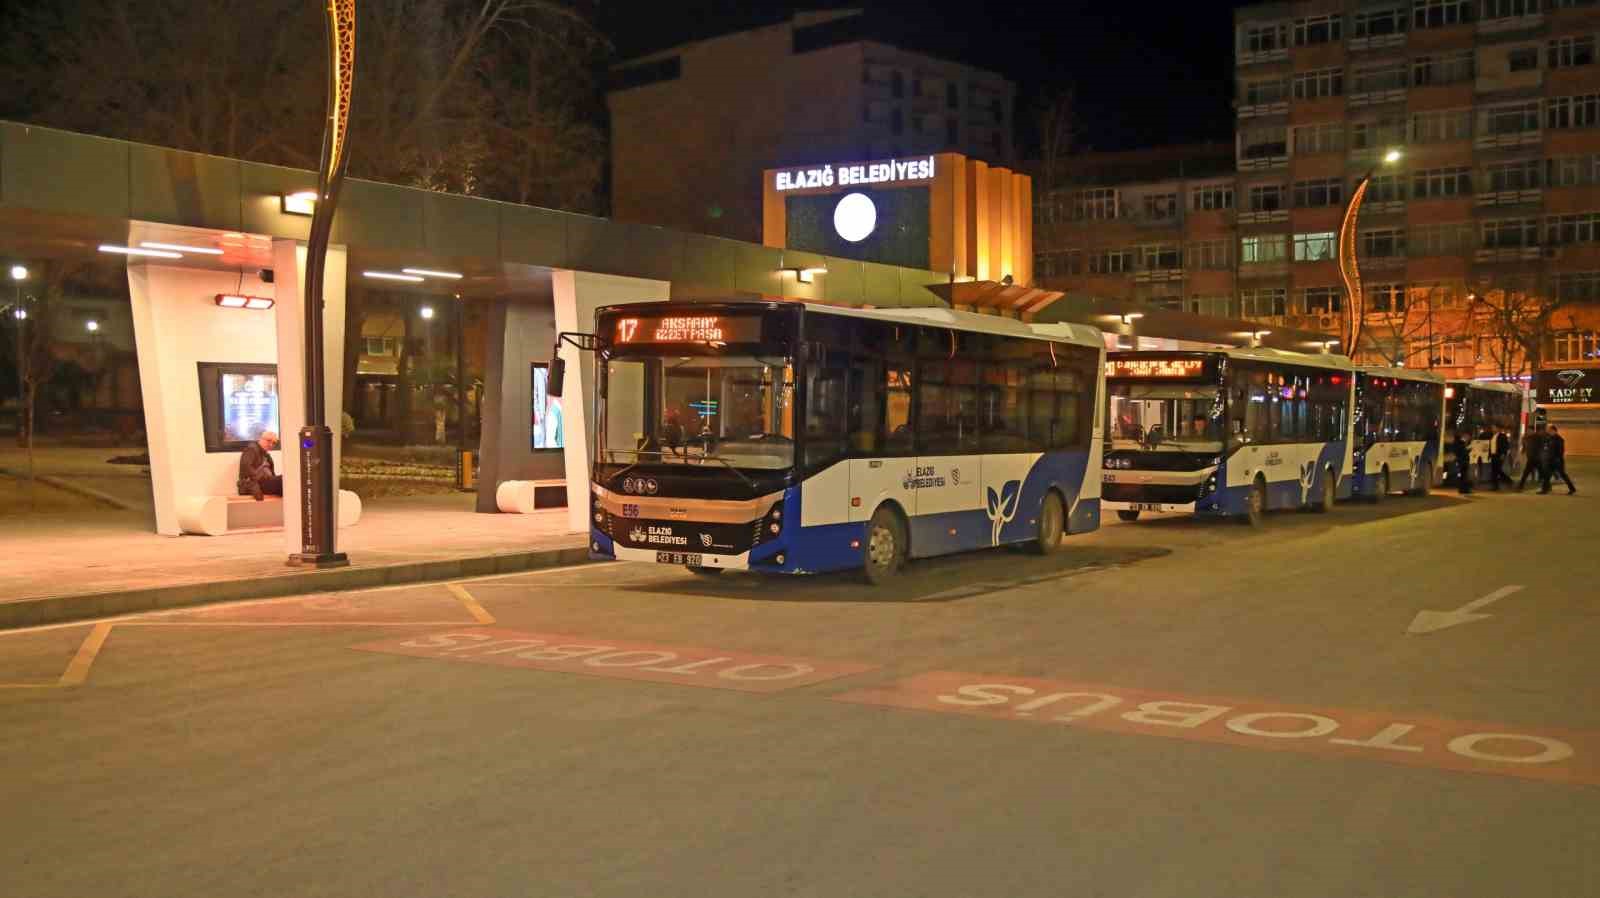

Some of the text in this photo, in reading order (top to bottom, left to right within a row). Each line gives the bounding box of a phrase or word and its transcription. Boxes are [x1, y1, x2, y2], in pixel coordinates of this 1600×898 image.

[776, 155, 935, 191] ELAZIĞ BELEDİYESİ
[618, 318, 639, 342] 17
[400, 632, 815, 681] OTOBÜS
[936, 683, 1574, 765] OTOBÜS
